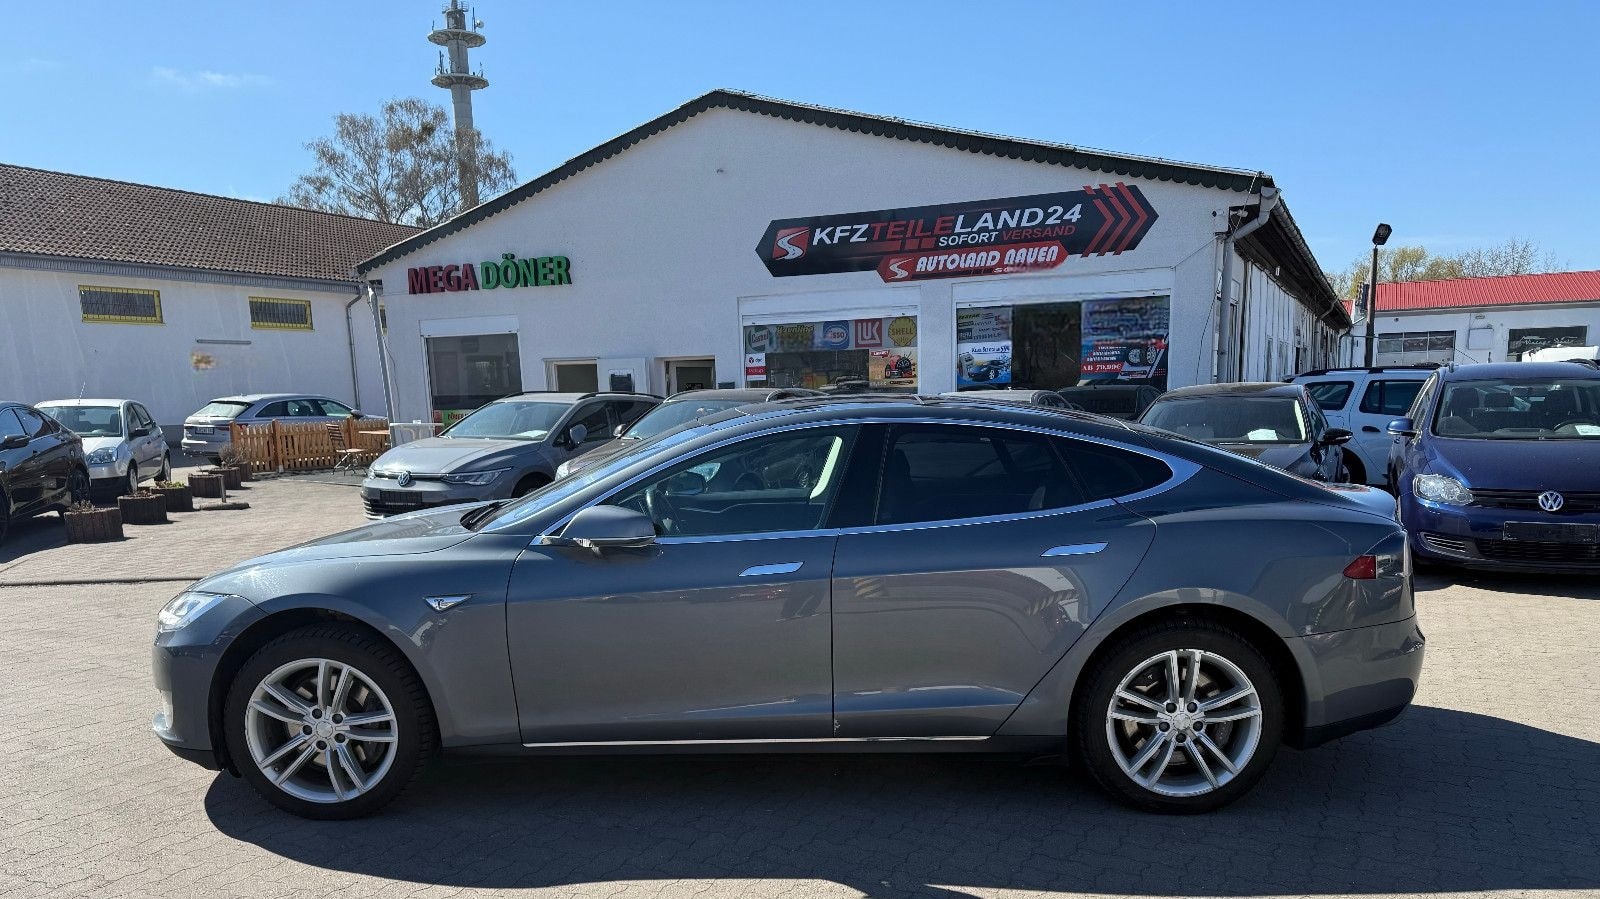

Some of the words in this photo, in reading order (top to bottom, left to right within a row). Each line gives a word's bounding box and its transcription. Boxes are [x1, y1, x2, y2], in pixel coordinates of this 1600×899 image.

[813, 204, 1082, 246] KFZTEILELAND24
[938, 232, 999, 247] SOFORT
[1002, 225, 1076, 241] VERSAND
[916, 251, 1000, 272] AUTOLAND
[408, 263, 480, 295] MEGA
[480, 253, 572, 290] DÖNER
[891, 327, 914, 336] SHELL
